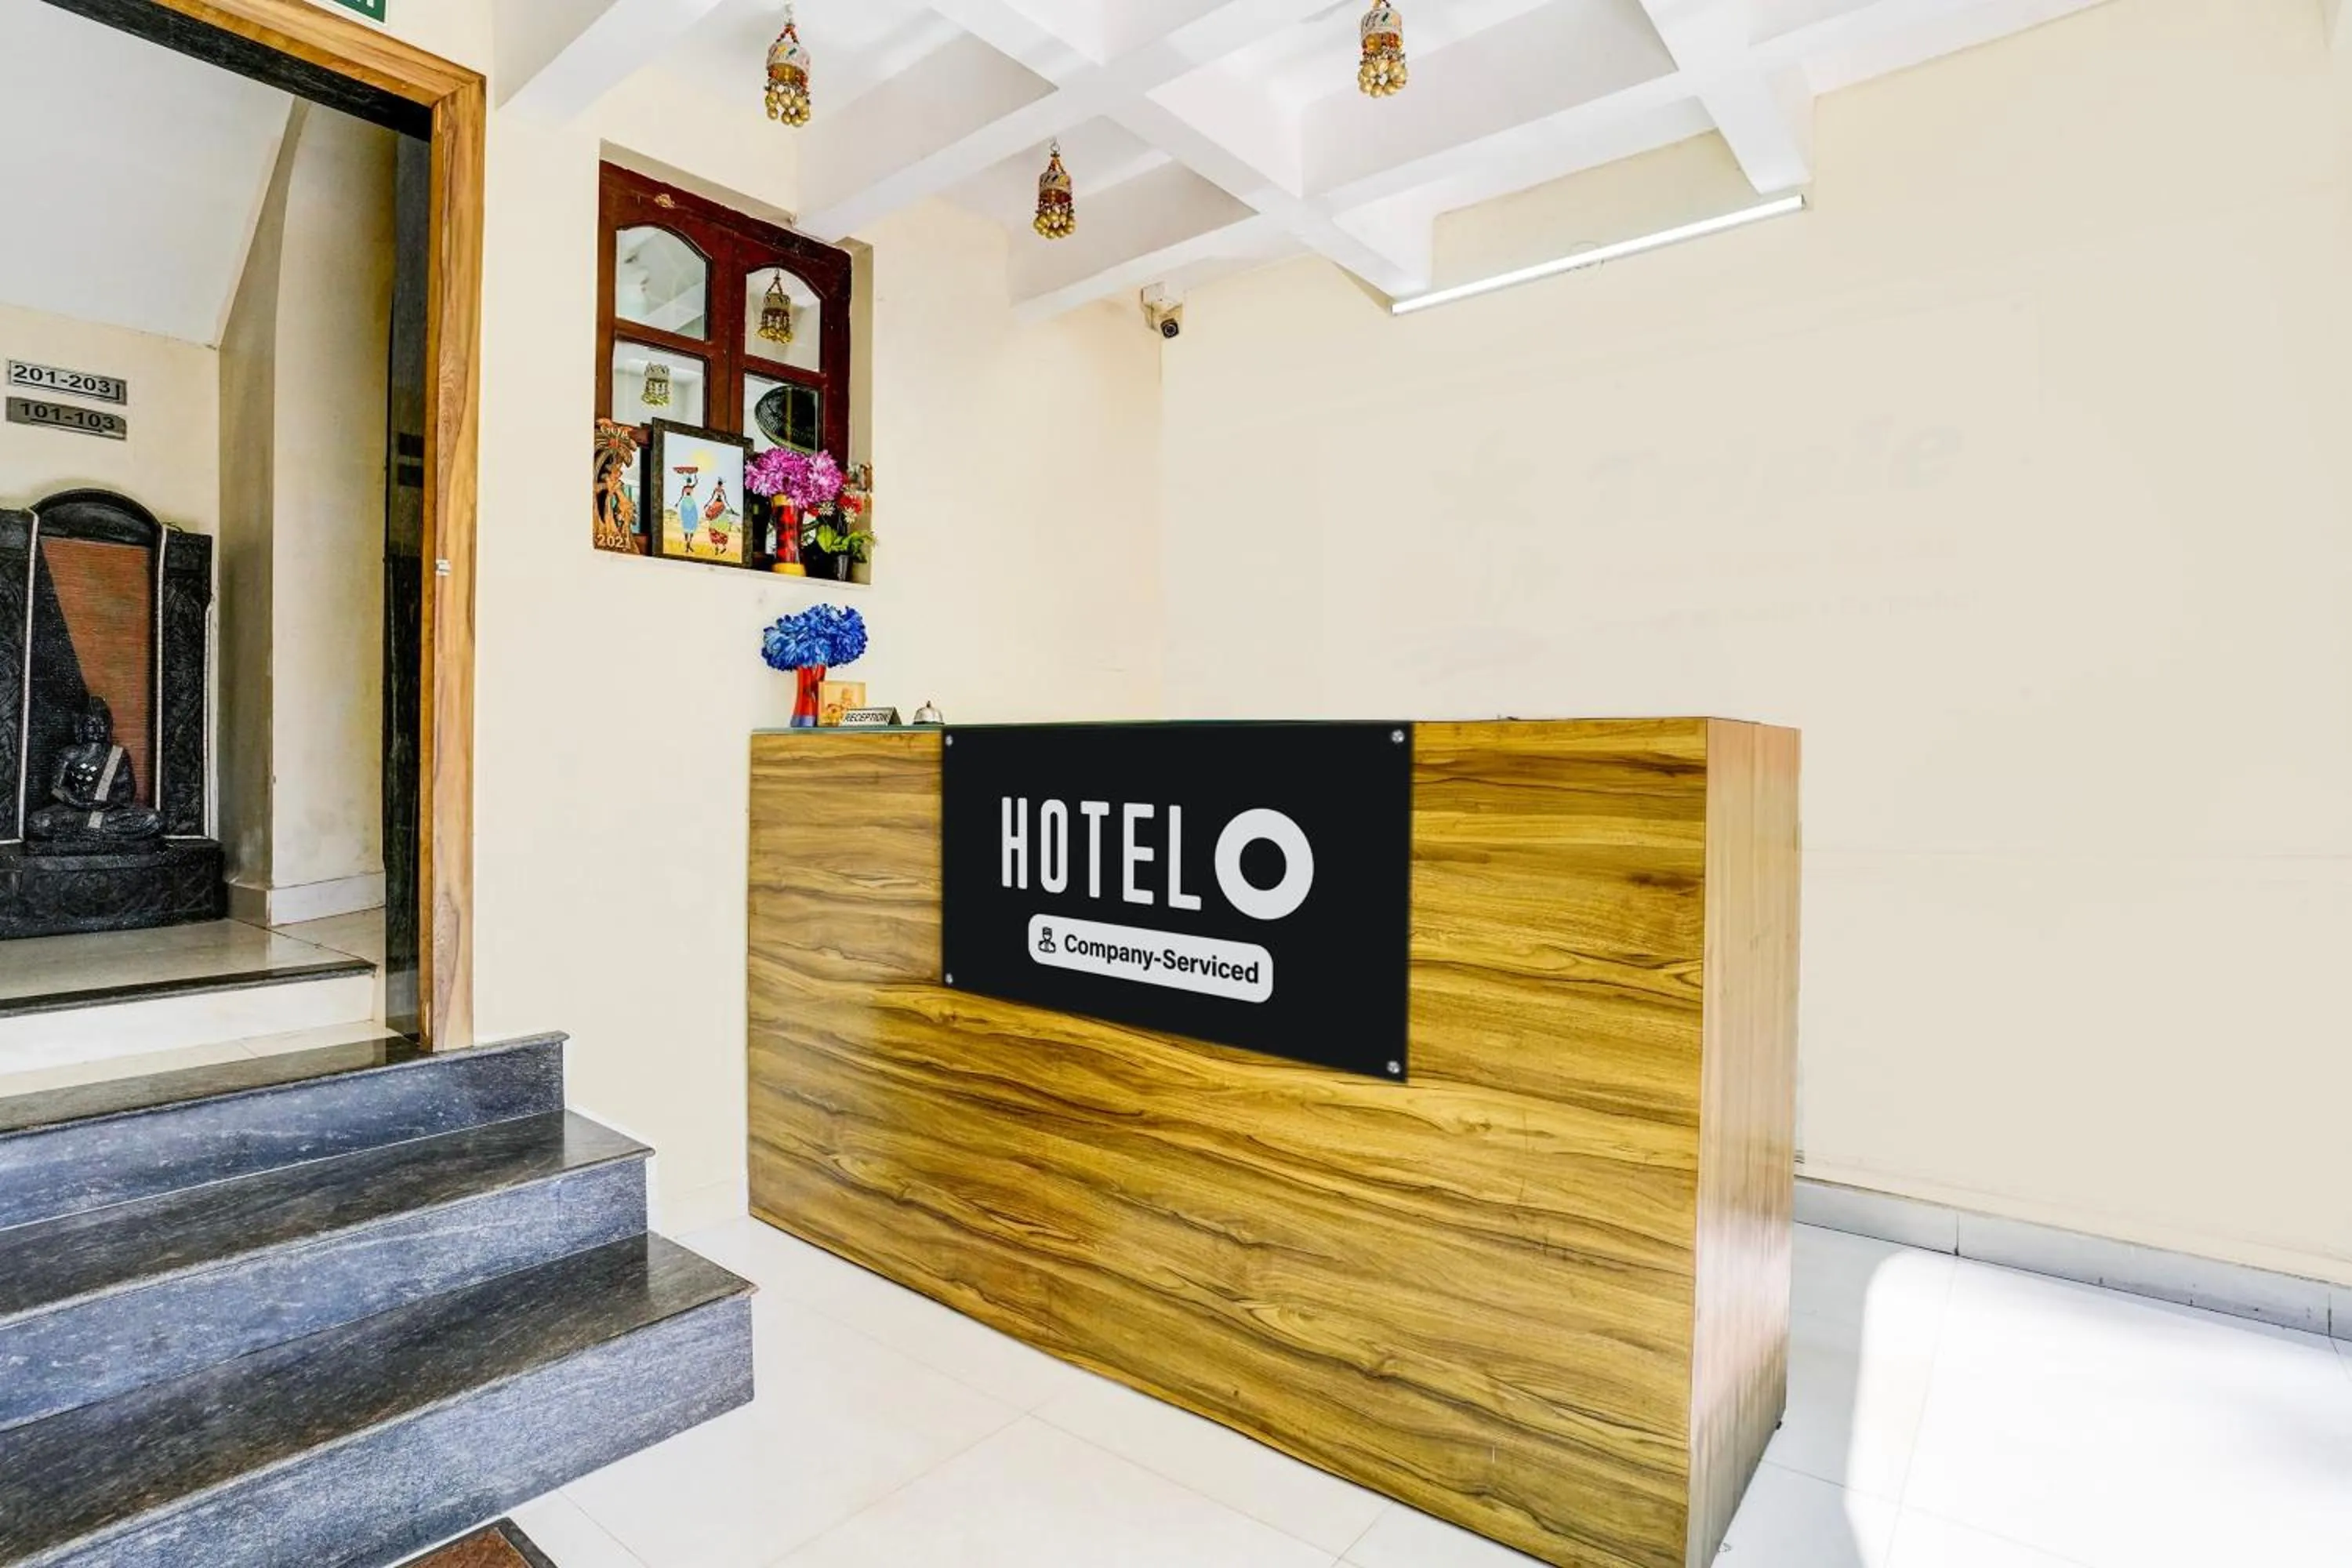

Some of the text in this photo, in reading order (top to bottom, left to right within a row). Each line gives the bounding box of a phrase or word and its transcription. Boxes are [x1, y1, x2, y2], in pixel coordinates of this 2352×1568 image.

[13, 365, 111, 393] 201-203
[20, 402, 115, 430] 101-103
[844, 712, 890, 722] RECEPTION
[1001, 797, 1202, 910] HOTEL
[1064, 934, 1259, 984] Company-Serviced
